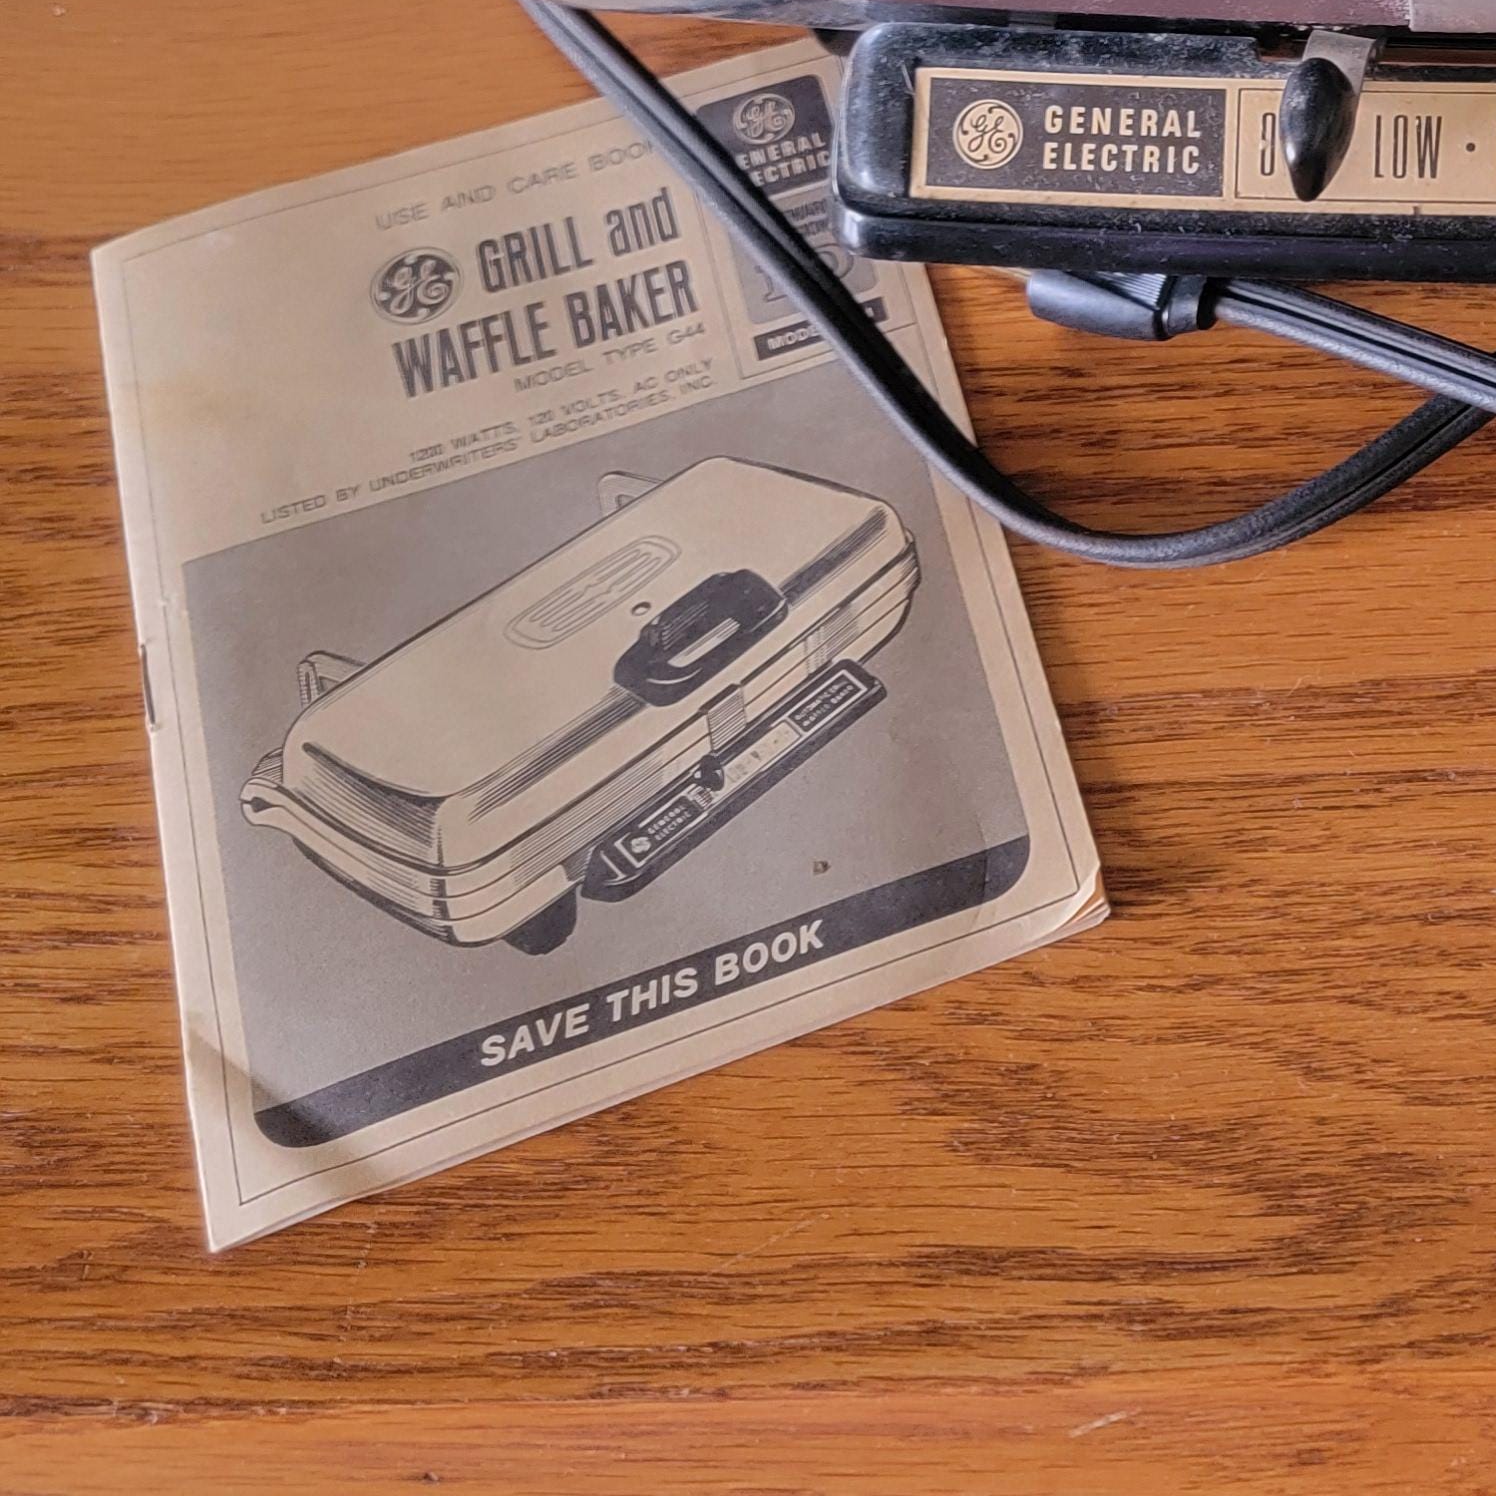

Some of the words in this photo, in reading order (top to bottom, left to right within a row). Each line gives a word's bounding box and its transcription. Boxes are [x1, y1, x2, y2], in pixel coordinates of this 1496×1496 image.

[1043, 105, 1201, 138] GENERAL
[735, 132, 827, 171] ENERAL
[748, 150, 830, 188] ECTRIC
[1042, 142, 1201, 174] ELECTRIC
[1374, 115, 1442, 179] LOW
[376, 203, 429, 231] USE
[441, 184, 496, 210] AND
[508, 162, 580, 194] CARE
[477, 217, 593, 293] GRILL
[605, 187, 679, 256] and
[391, 301, 557, 398] WAFFLE
[564, 260, 699, 349] BAKER
[514, 359, 595, 392] MODEL
[602, 338, 658, 365] TYPE
[664, 357, 713, 383] ONLY
[260, 494, 326, 524] LISTED
[336, 483, 360, 502] BY
[480, 1003, 590, 1067] SAVE
[605, 967, 698, 1022] THIS
[714, 919, 824, 986] BOOK
